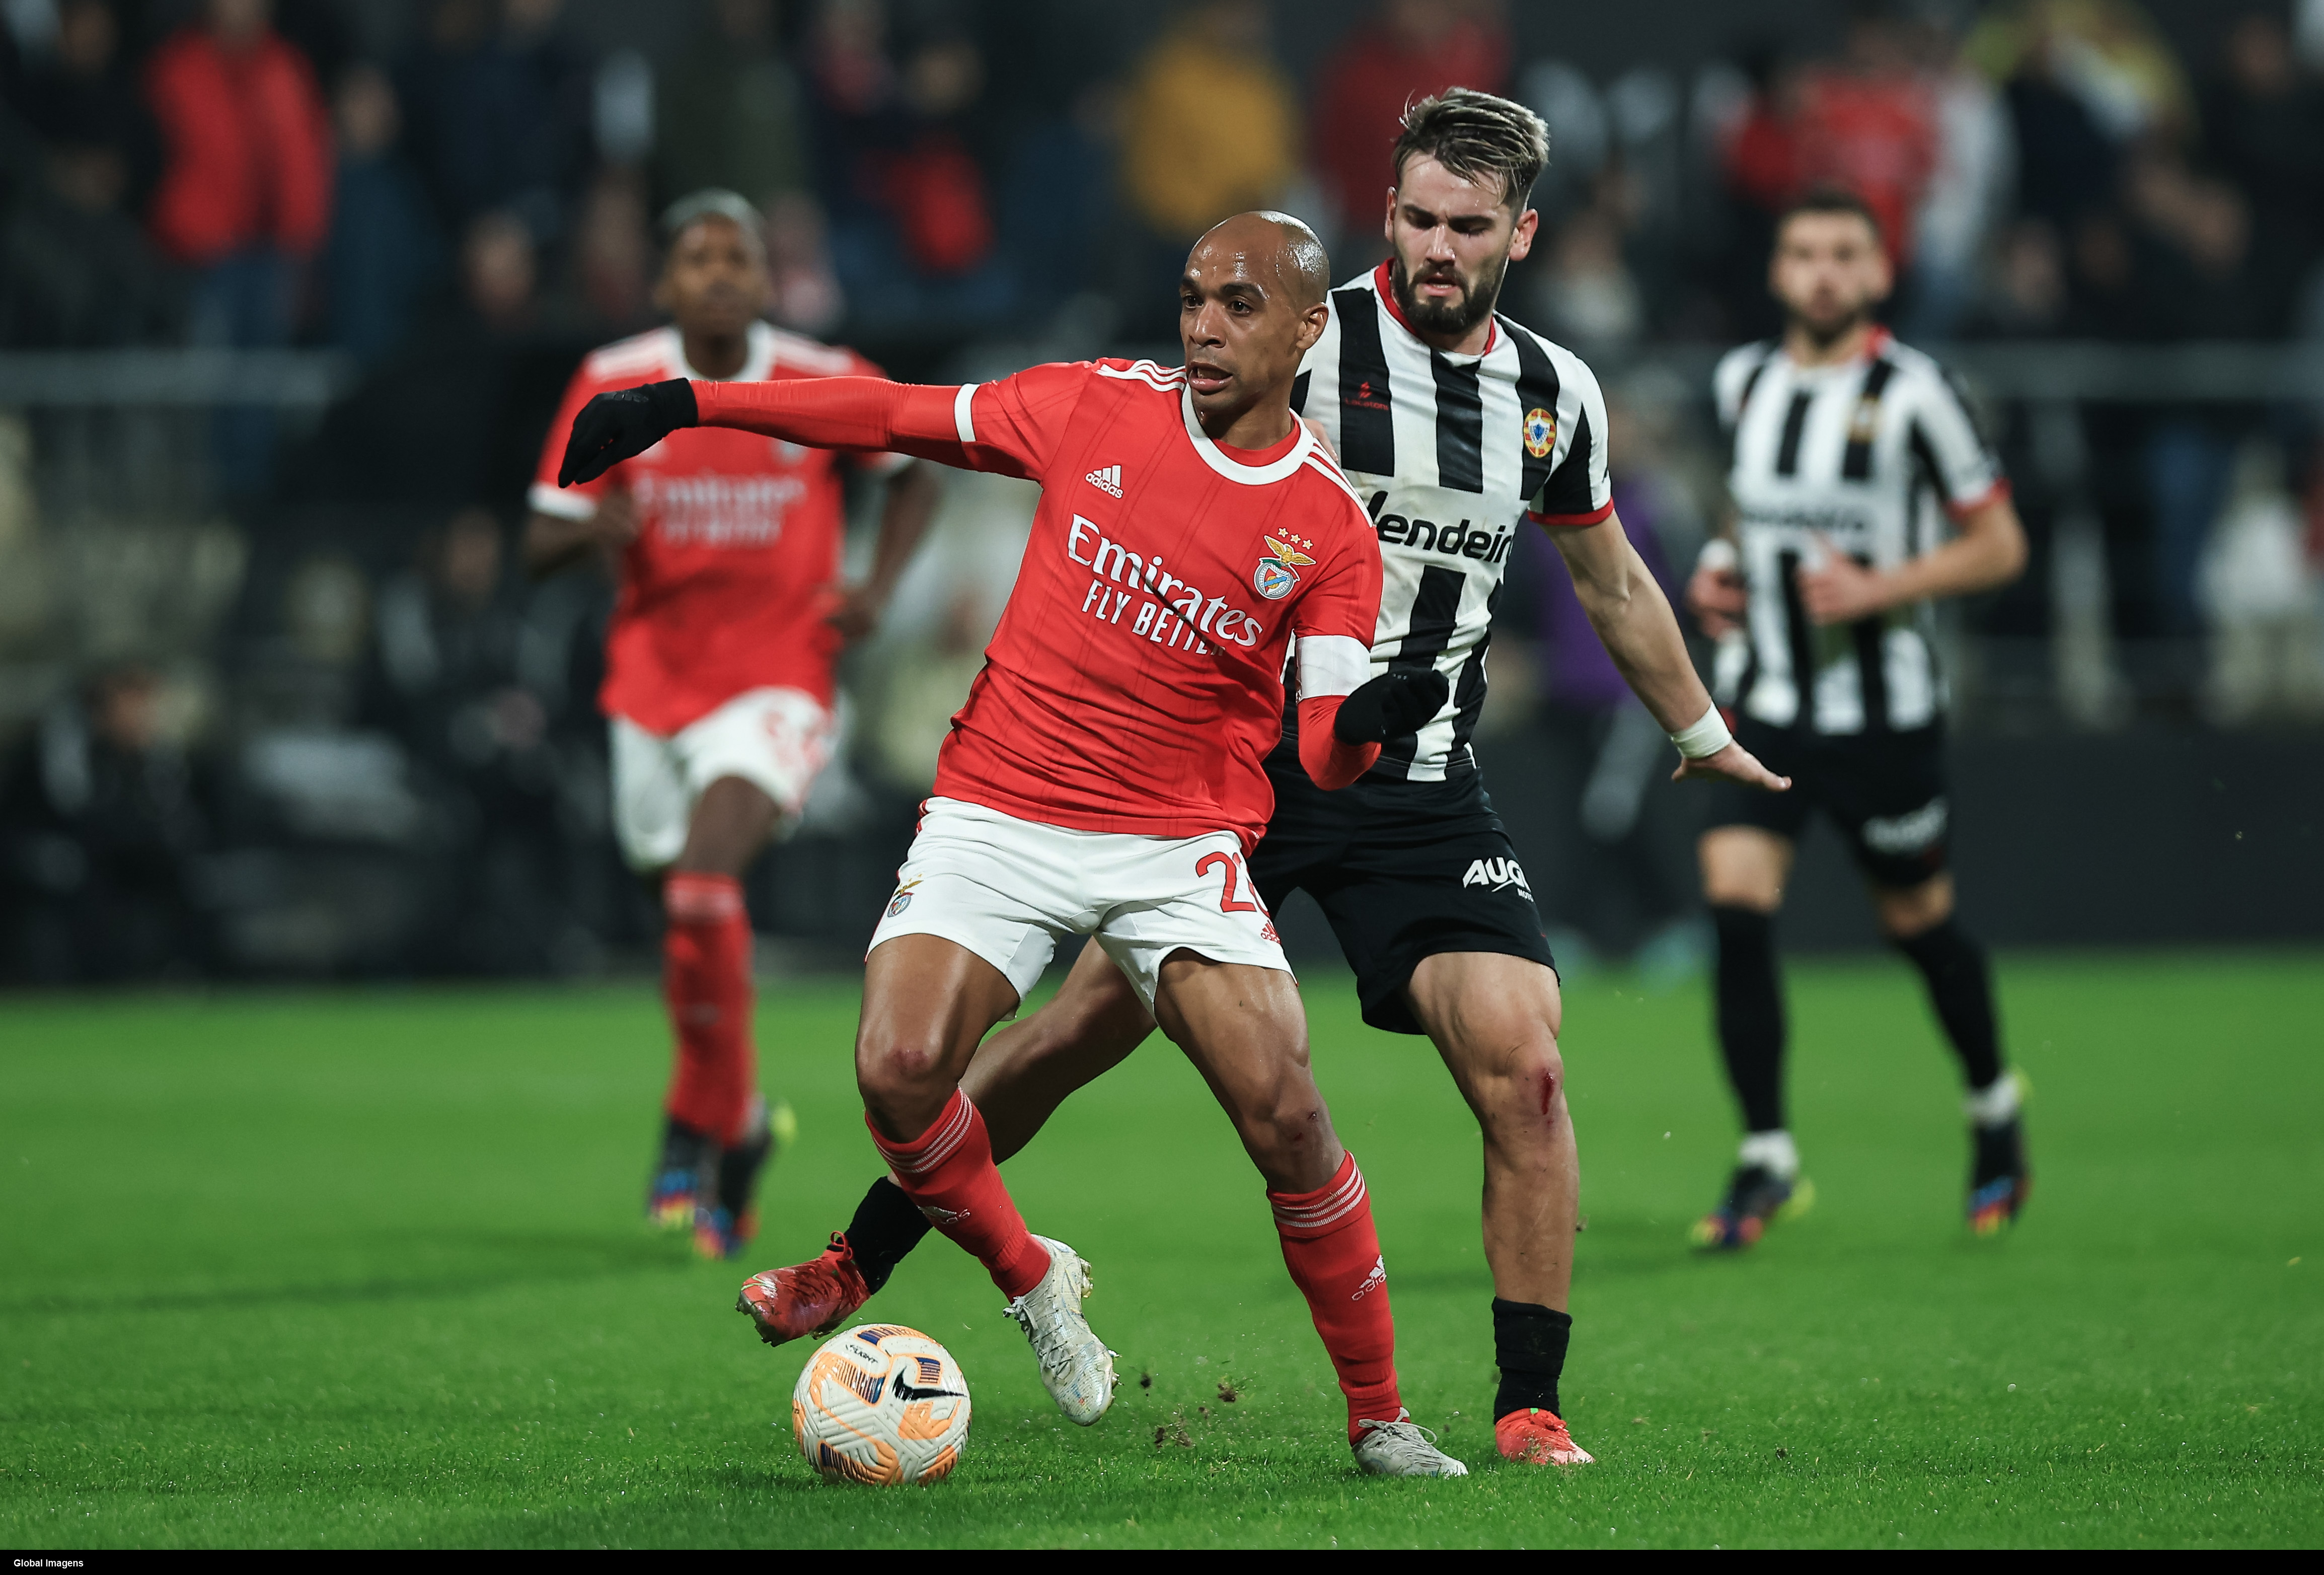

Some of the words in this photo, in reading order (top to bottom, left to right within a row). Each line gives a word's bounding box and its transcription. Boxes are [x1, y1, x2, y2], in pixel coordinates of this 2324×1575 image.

[1085, 473, 1123, 498] adidas
[1068, 513, 1263, 647] Emirates
[1082, 579, 1132, 624] FLY
